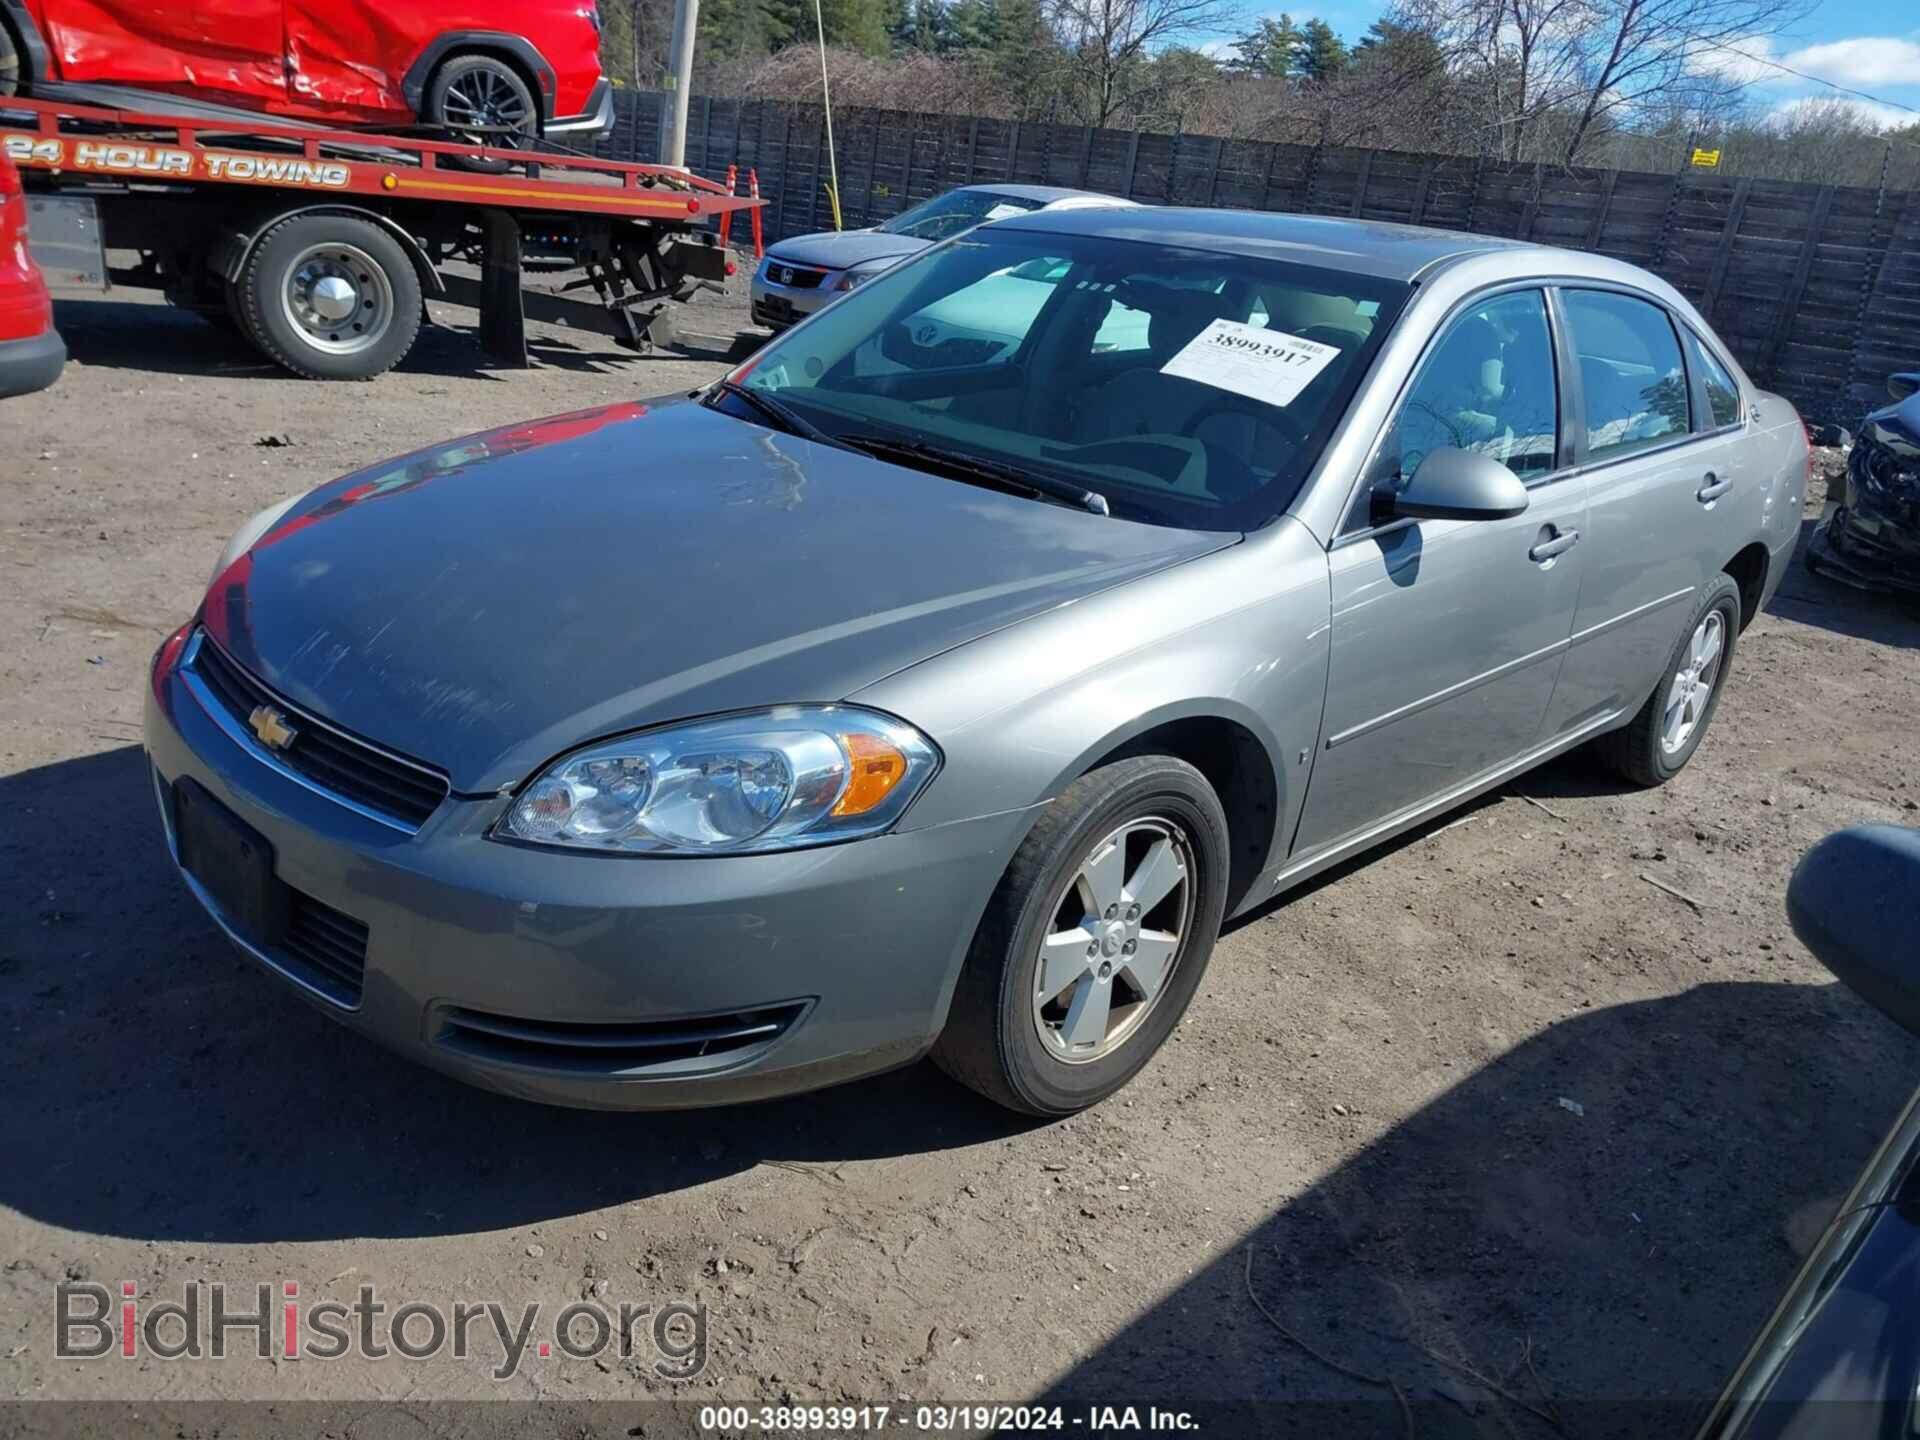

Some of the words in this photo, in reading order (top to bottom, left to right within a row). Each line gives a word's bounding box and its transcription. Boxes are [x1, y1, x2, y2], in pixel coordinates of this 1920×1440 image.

[5, 137, 60, 161] 24
[77, 144, 191, 173] HOUR
[205, 153, 348, 185] TOWING
[1208, 333, 1312, 367] 38993917
